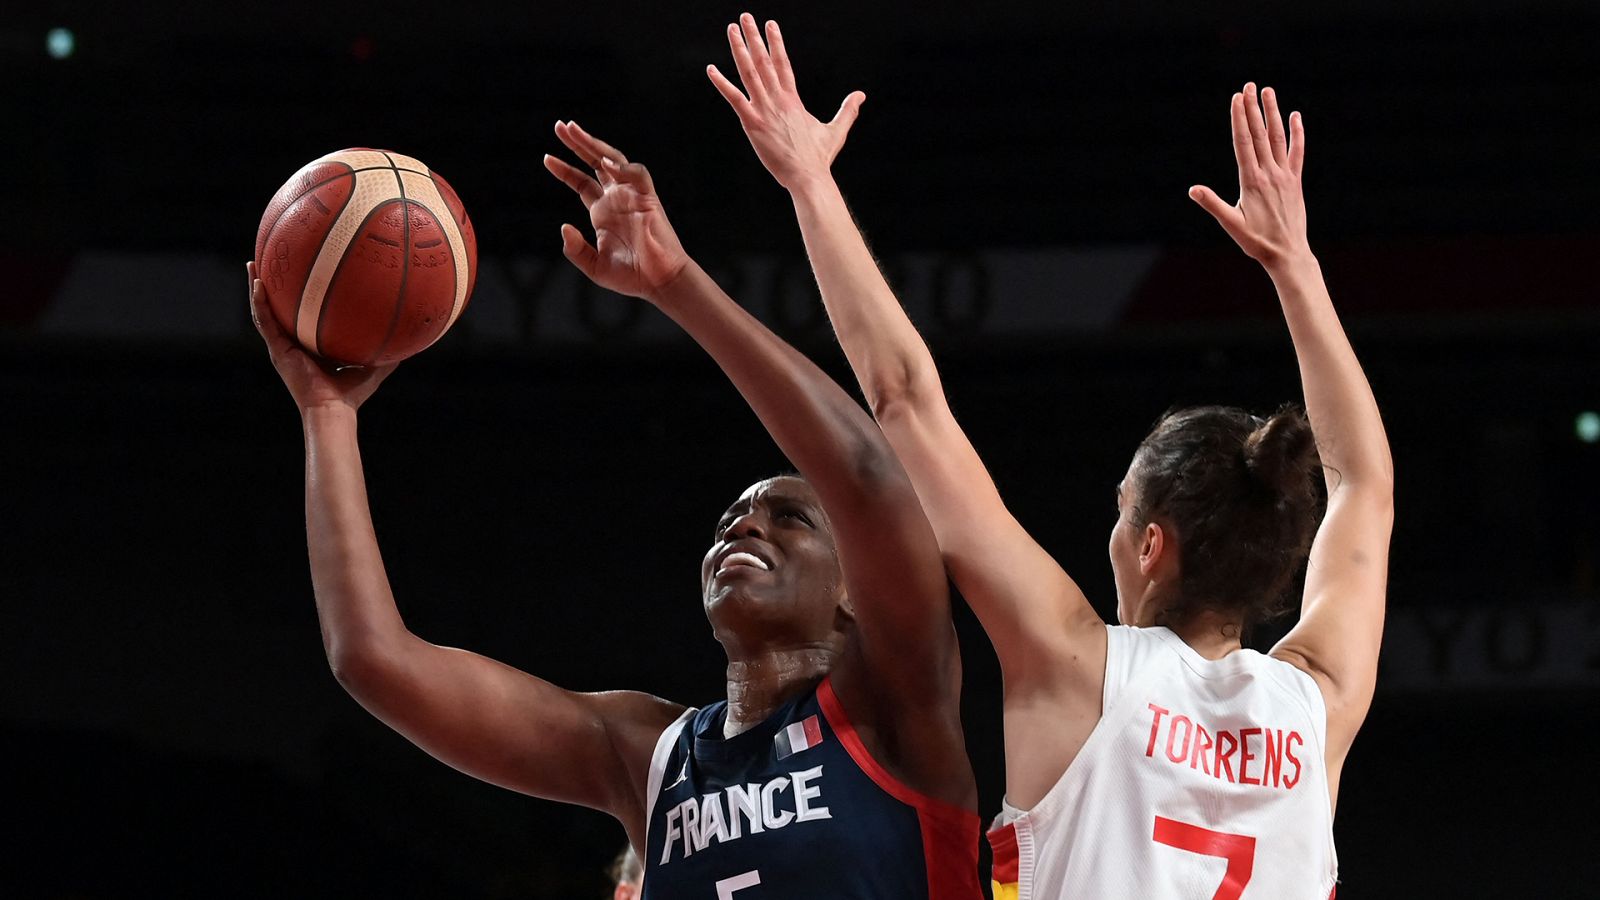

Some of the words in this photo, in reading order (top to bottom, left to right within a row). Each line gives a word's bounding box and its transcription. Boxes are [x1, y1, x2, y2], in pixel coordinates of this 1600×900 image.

[1146, 703, 1303, 789] TORRENS
[658, 765, 832, 865] FRANCE
[1152, 816, 1256, 900] 7
